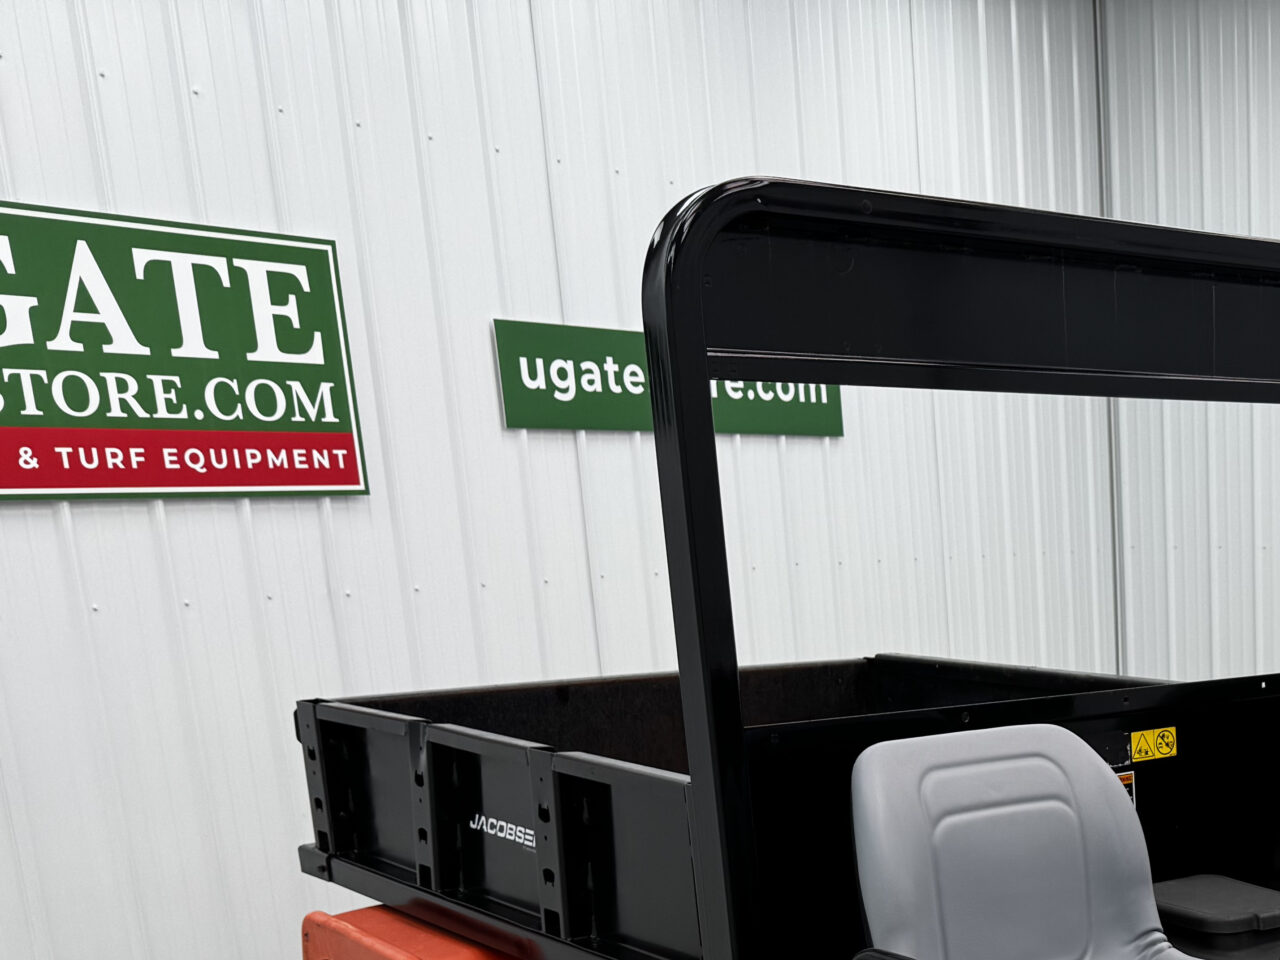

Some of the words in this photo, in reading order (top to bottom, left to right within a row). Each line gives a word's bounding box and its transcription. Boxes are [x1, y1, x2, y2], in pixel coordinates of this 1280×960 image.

[0, 367, 340, 423] TORE.COM
[519, 355, 828, 404] ugatee.com
[18, 446, 40, 469] &
[54, 447, 146, 469] TURF
[163, 447, 348, 473] EQUIPMENT
